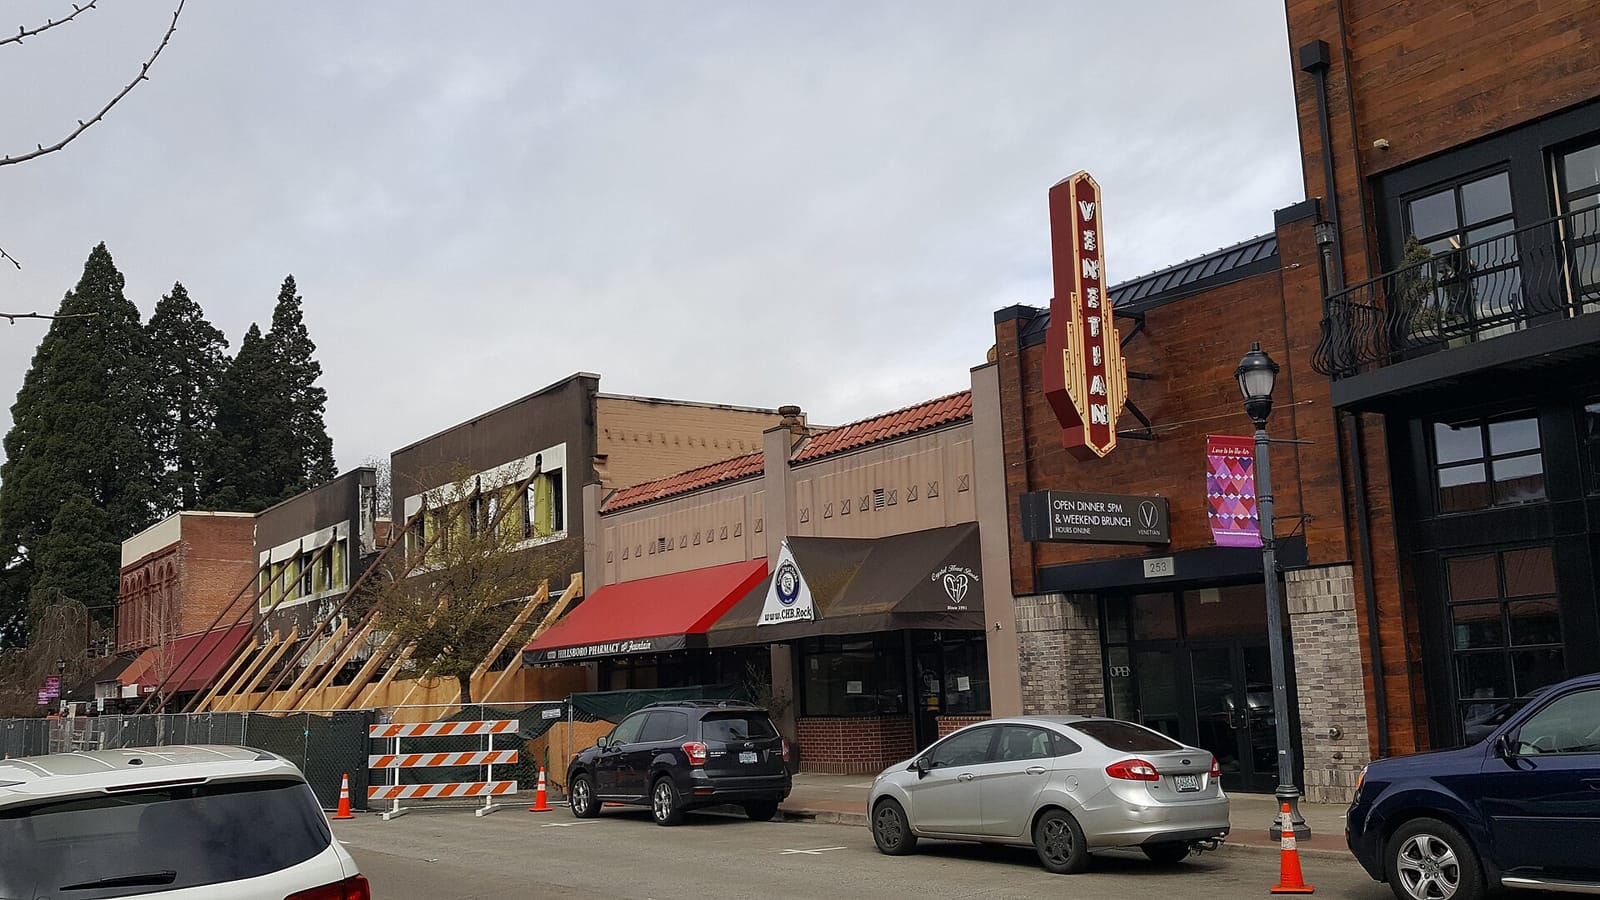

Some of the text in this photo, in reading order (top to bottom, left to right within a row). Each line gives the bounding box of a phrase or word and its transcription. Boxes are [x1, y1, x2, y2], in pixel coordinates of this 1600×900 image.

[1078, 200, 1109, 424] VENETIAN
[1053, 500, 1123, 513] OPEN DINNER 5PM
[1055, 513, 1132, 527] & WEEKEND BRUNCH
[1055, 526, 1091, 535] HOURS ONLINE
[1150, 562, 1167, 573] 253
[764, 606, 813, 621] www.CHB.Rock
[557, 646, 588, 659] HILLSBORO
[588, 642, 621, 656] PHARMACY
